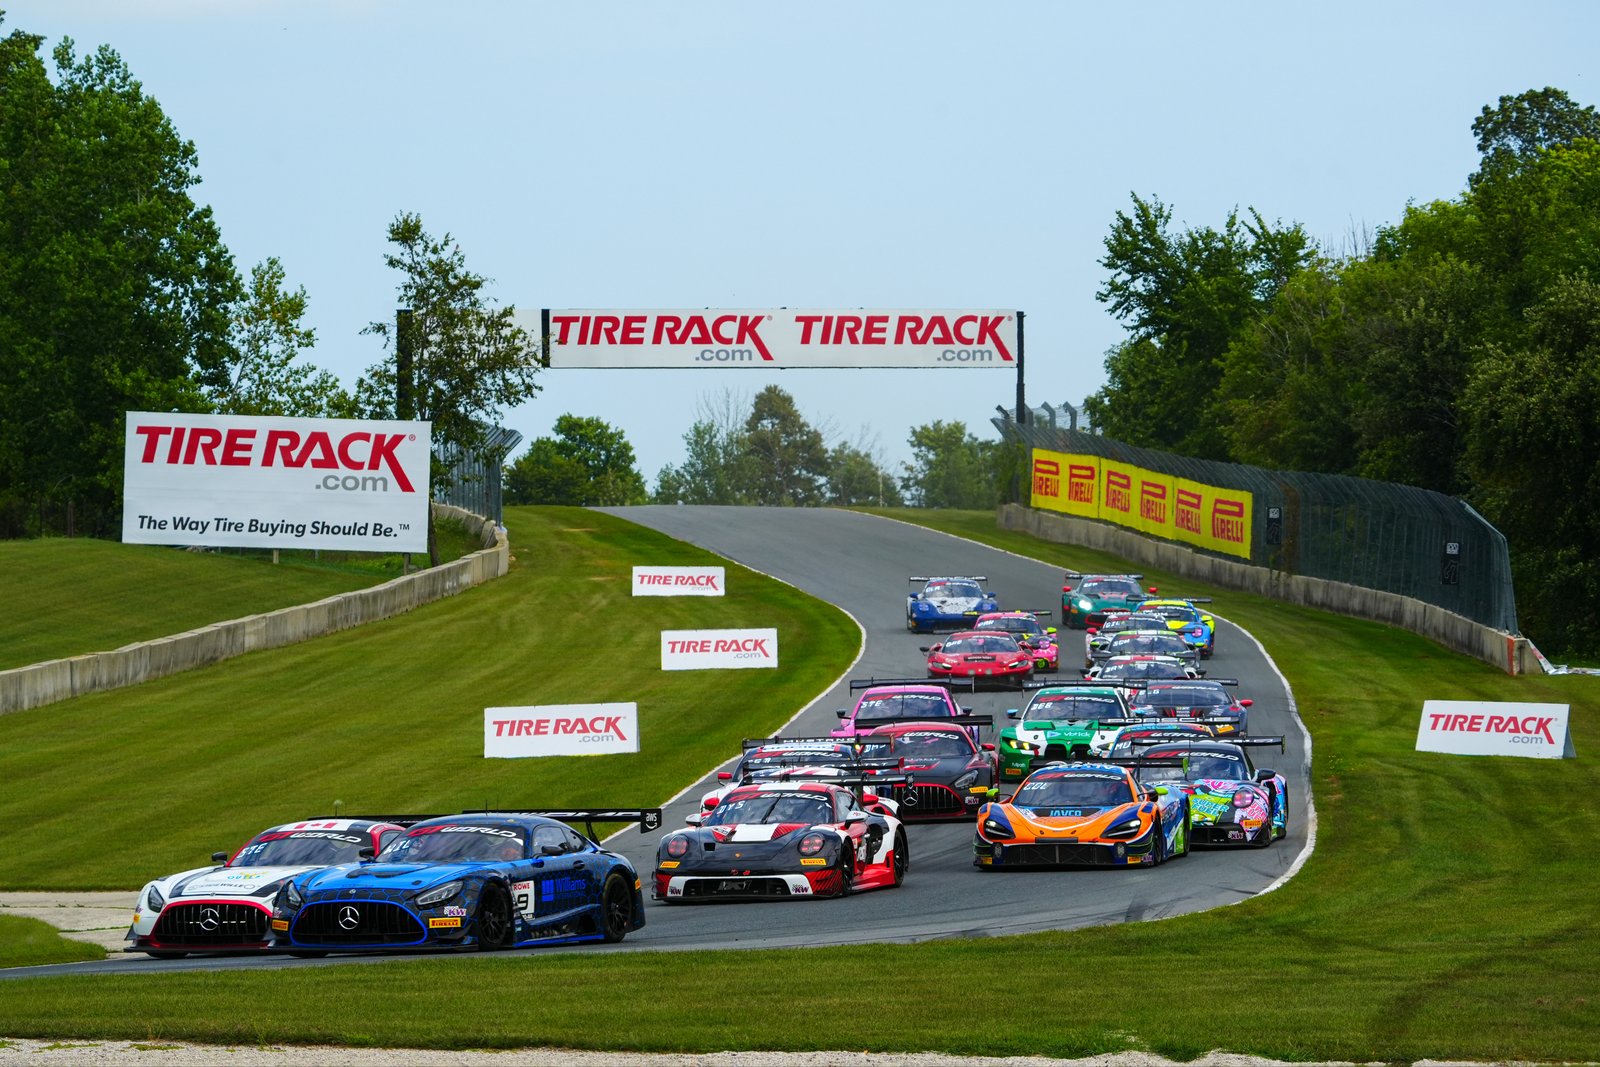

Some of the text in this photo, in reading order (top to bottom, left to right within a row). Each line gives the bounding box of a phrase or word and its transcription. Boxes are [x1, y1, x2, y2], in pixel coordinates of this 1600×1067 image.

[552, 315, 647, 345] TIRE
[795, 315, 888, 345] TIRE
[695, 348, 753, 362] .com
[936, 348, 993, 362] .com
[136, 425, 257, 466] TIRE
[315, 474, 388, 492] .com
[1033, 459, 1060, 497] PIRELLI
[1068, 464, 1095, 504] PIRELLI
[1106, 470, 1131, 513] PIRELLI
[1140, 481, 1166, 524] PIRELLI
[1176, 488, 1202, 534] PIRELLI
[138, 515, 168, 530] The
[173, 517, 210, 534] Way
[214, 518, 245, 533] Tire
[248, 519, 306, 537] Buying
[310, 520, 368, 536] Should
[1212, 498, 1244, 543] PIRELLI
[638, 574, 672, 585] TIRE
[668, 640, 712, 653] TIRE
[492, 719, 551, 736] TIRE
[1430, 714, 1485, 731] TIRE
[578, 733, 614, 743] .com
[1509, 736, 1543, 744] .com
[1177, 751, 1239, 761] WORLD
[760, 792, 828, 802] WORLD
[1191, 797, 1230, 813] SUPER
[1191, 804, 1219, 816] FUEL
[646, 813, 657, 822] aws
[290, 832, 361, 843] WORLD
[441, 826, 517, 838] WORLD
[513, 882, 530, 891] ROWE
[556, 877, 586, 892] Williams
